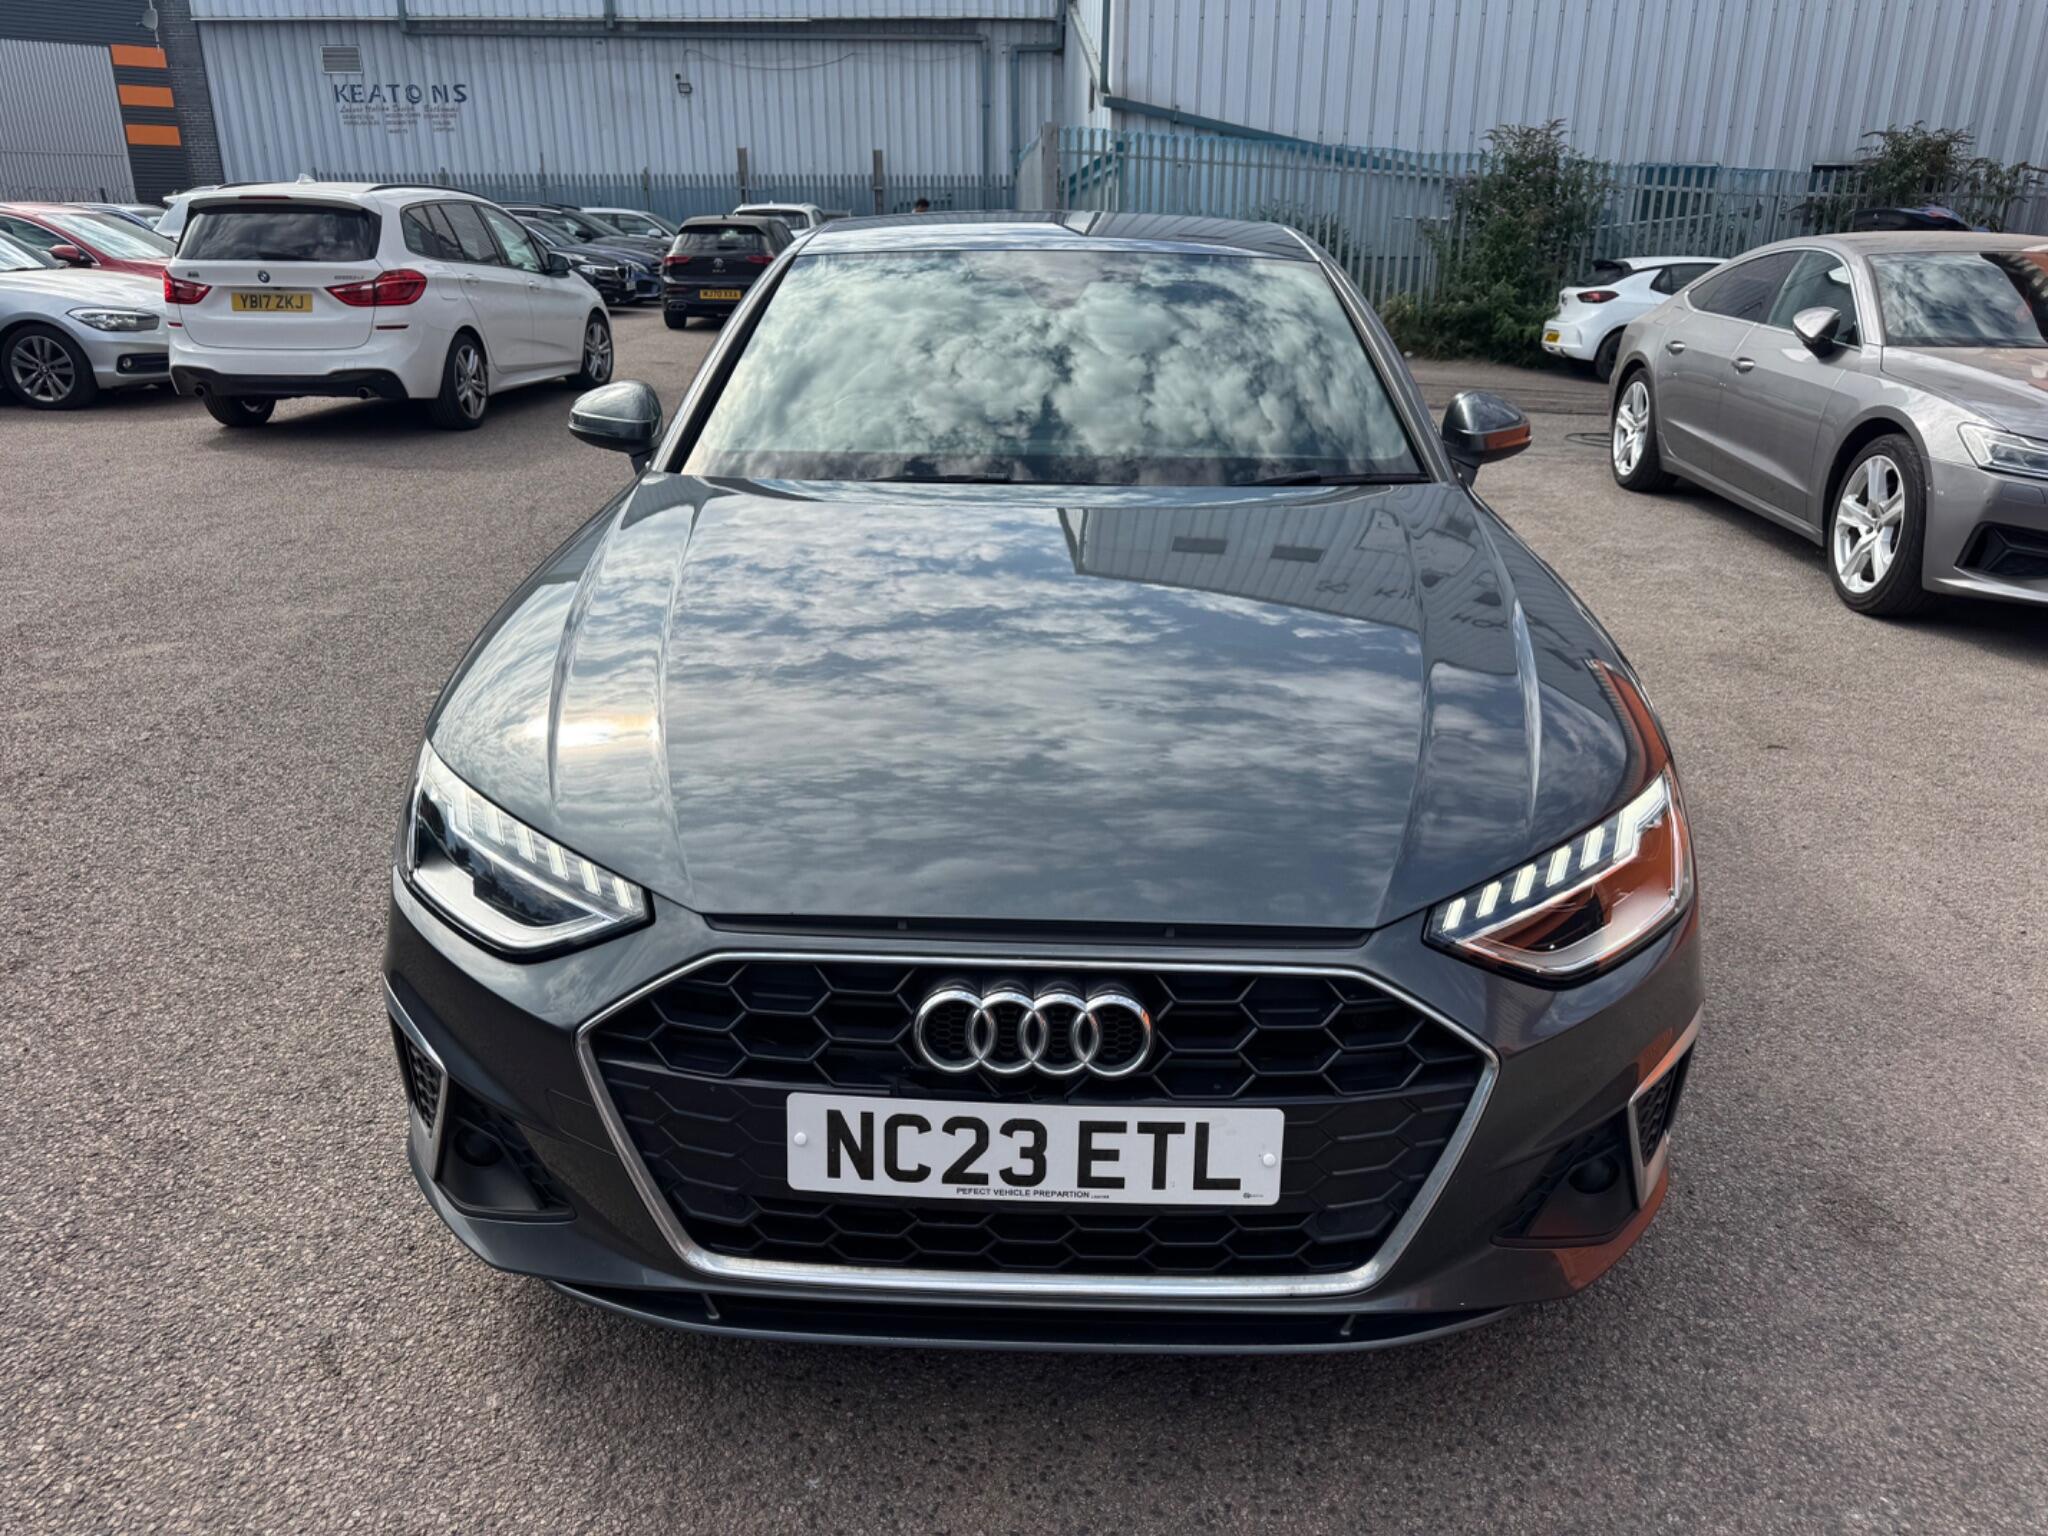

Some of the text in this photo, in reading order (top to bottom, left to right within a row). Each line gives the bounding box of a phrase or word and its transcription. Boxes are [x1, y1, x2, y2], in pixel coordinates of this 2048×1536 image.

[334, 84, 467, 104] KEATONS
[240, 294, 304, 309] YB17 ZKJ
[826, 1109, 1242, 1191] NC23 ETL
[956, 1187, 991, 1196] PEFECT
[993, 1188, 1030, 1197] VEHICLE
[1033, 1189, 1090, 1199] PREPARTION
